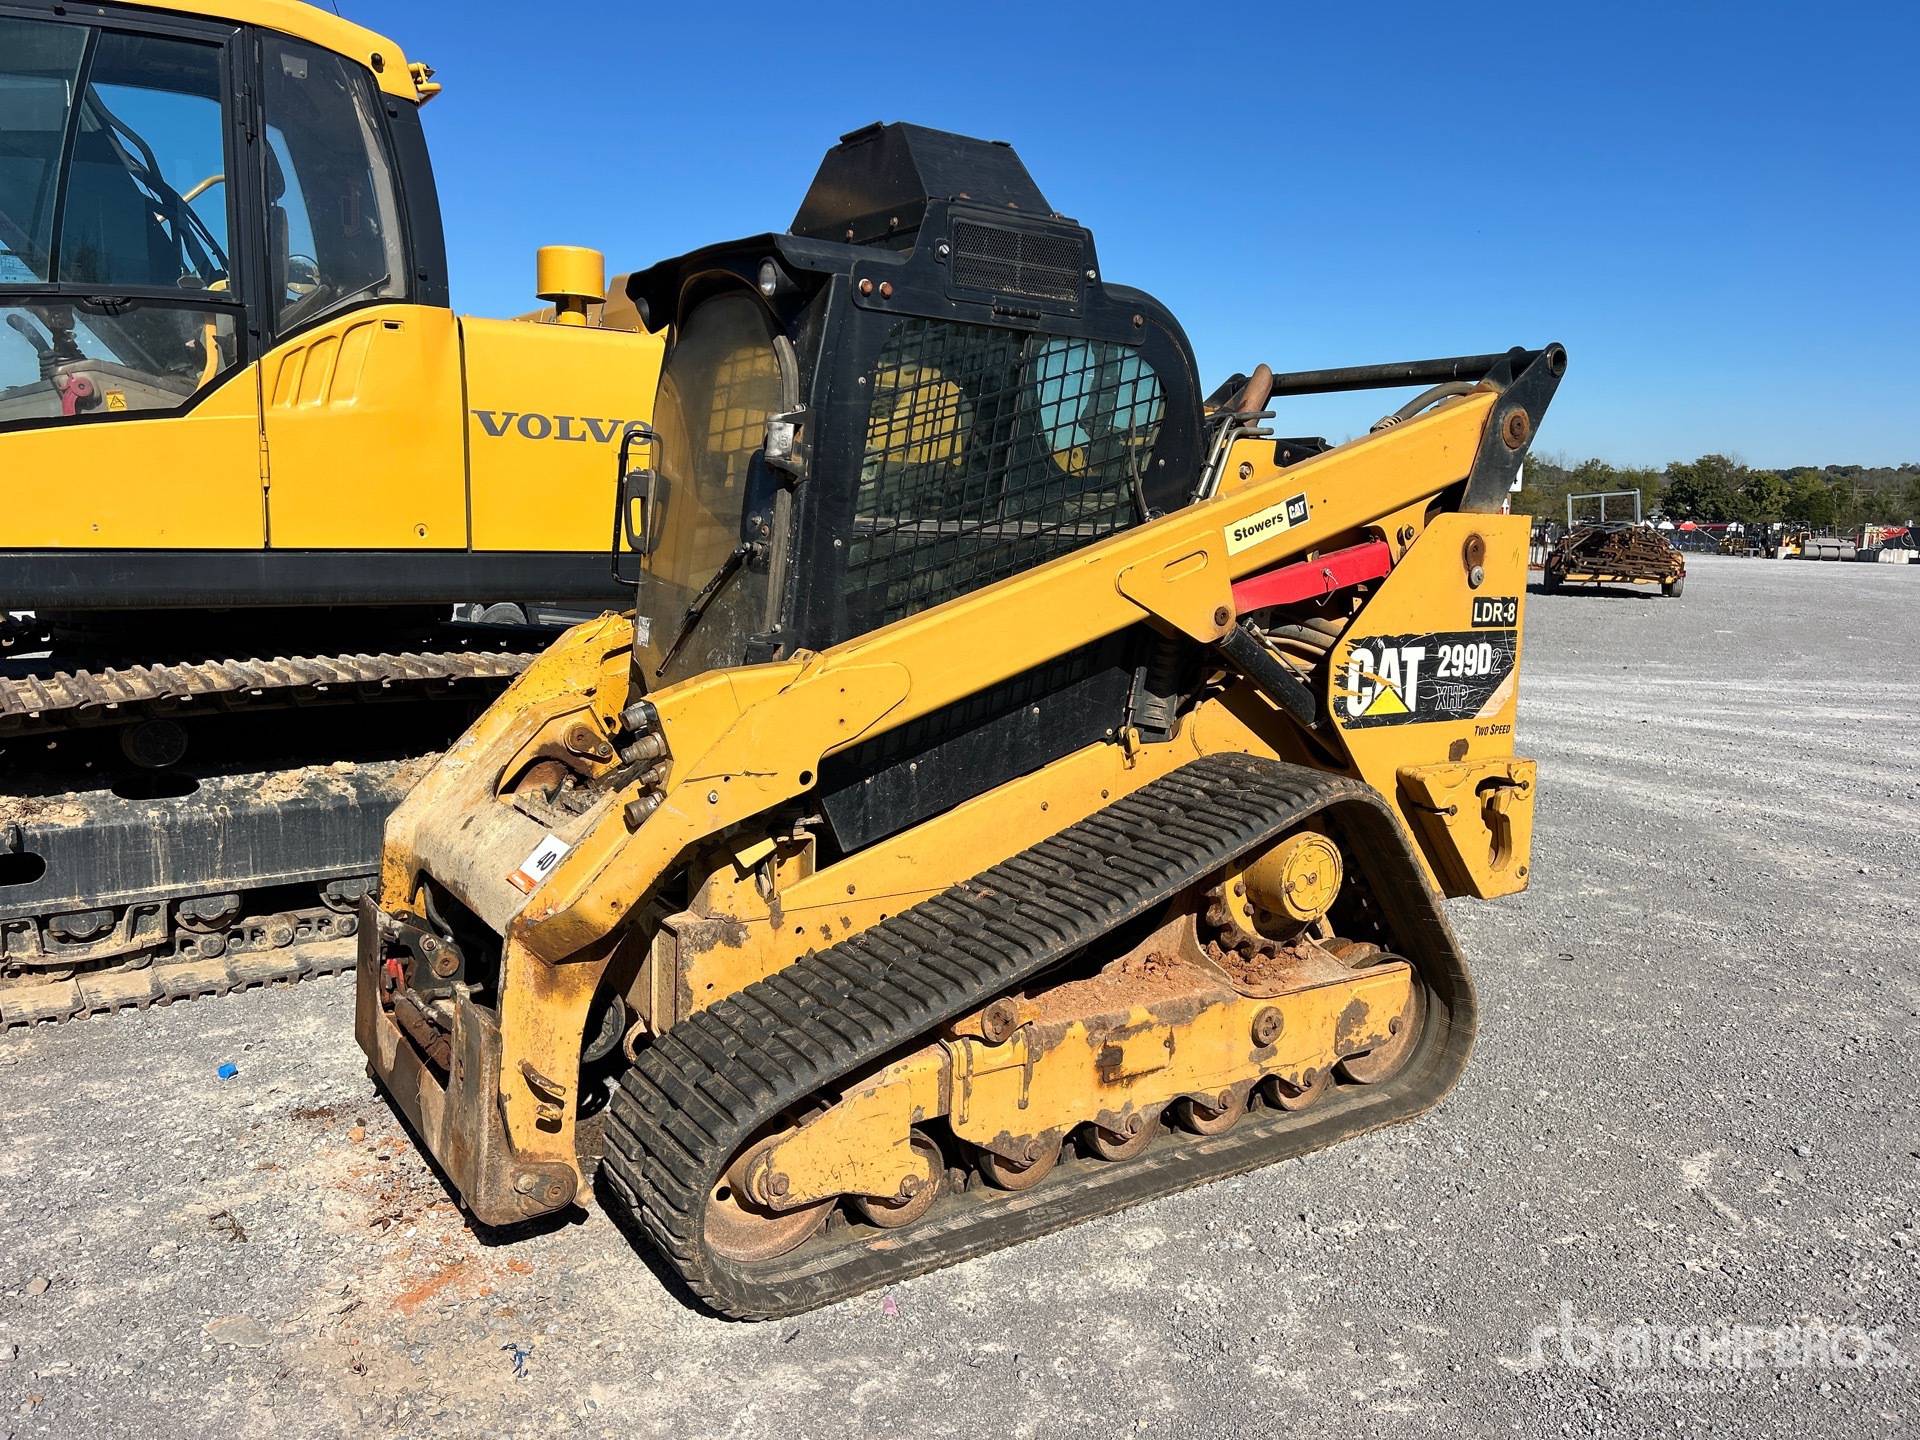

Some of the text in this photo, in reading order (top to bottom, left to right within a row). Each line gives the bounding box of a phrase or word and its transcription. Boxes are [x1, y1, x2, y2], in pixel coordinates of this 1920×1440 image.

[470, 409, 653, 446] VOLVO
[1233, 500, 1305, 542] Stowers CAT
[1473, 602, 1516, 622] LDR-8
[1346, 642, 1502, 717] CAT 299D2
[1435, 684, 1469, 711] XHP
[535, 850, 557, 872] 40
